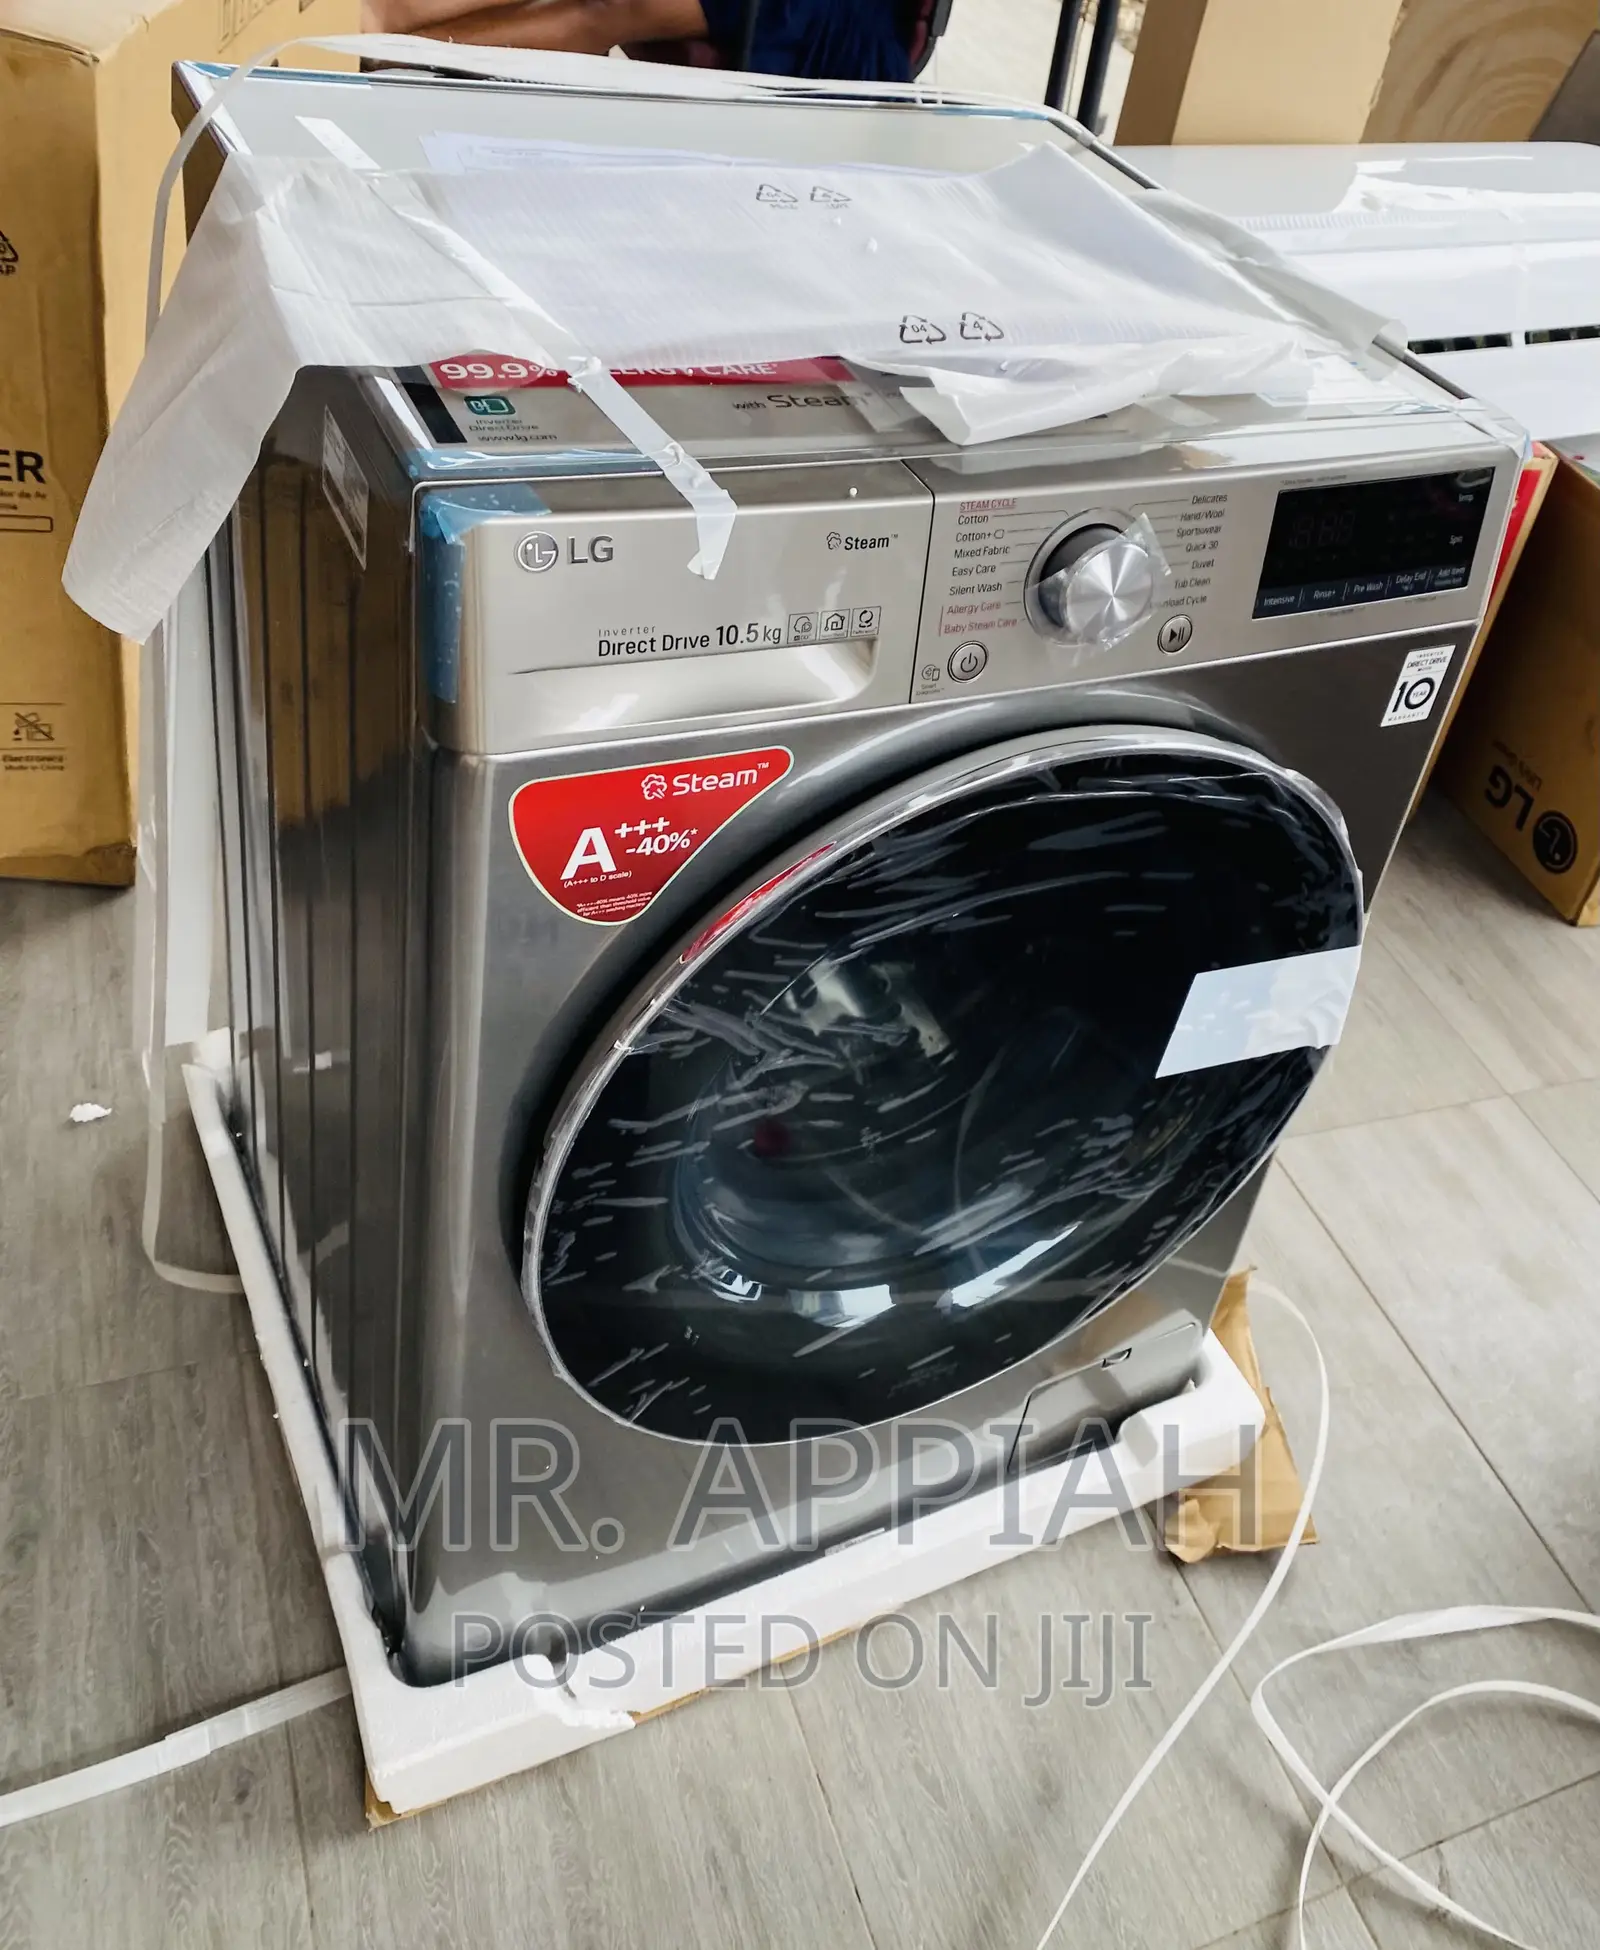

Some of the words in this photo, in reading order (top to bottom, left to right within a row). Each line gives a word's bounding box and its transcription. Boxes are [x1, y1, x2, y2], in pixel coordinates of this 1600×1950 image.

[439, 362, 558, 380] 99.9%
[959, 499, 990, 511] STEAM
[991, 497, 1018, 508] CYCLE
[1191, 494, 1228, 505] Delicates
[957, 514, 989, 526] Cotton
[1180, 508, 1226, 522] Hand/Wool
[1176, 525, 1223, 538] Sportswear
[566, 535, 614, 565] LG
[954, 547, 981, 559] Mixed
[982, 545, 1011, 556] Fabric
[1185, 543, 1206, 553] Quick
[1208, 540, 1219, 550] 30
[951, 566, 974, 577] Easy
[975, 563, 997, 574] Care
[1191, 558, 1215, 570] Duvet
[1174, 579, 1188, 589] Tub
[1189, 577, 1212, 588] Clean
[1395, 574, 1414, 585] Delay
[1414, 570, 1428, 581] End
[949, 585, 976, 596] Silent
[977, 581, 1003, 593] Wash
[1353, 584, 1365, 594] Pre
[1365, 580, 1384, 592] Wash
[1185, 595, 1208, 607] Cycle
[1263, 595, 1296, 606] Intensive
[946, 604, 979, 615] Allergy
[980, 601, 1002, 612] Care
[598, 625, 656, 638] Inverter
[943, 623, 967, 635] Baby
[967, 620, 996, 632] Steam
[997, 618, 1018, 628] Care
[598, 637, 657, 657] Direct
[661, 634, 710, 652] Drive
[715, 622, 759, 646] 10.5
[762, 625, 782, 645] kg
[1406, 658, 1429, 669] DIRECT
[1428, 655, 1449, 665] DRIVE
[1391, 677, 1436, 713] 10
[1484, 764, 1535, 832] LG
[563, 878, 589, 889] (A+++
[589, 875, 599, 883] to
[599, 874, 607, 882] D
[607, 870, 633, 880] scale)
